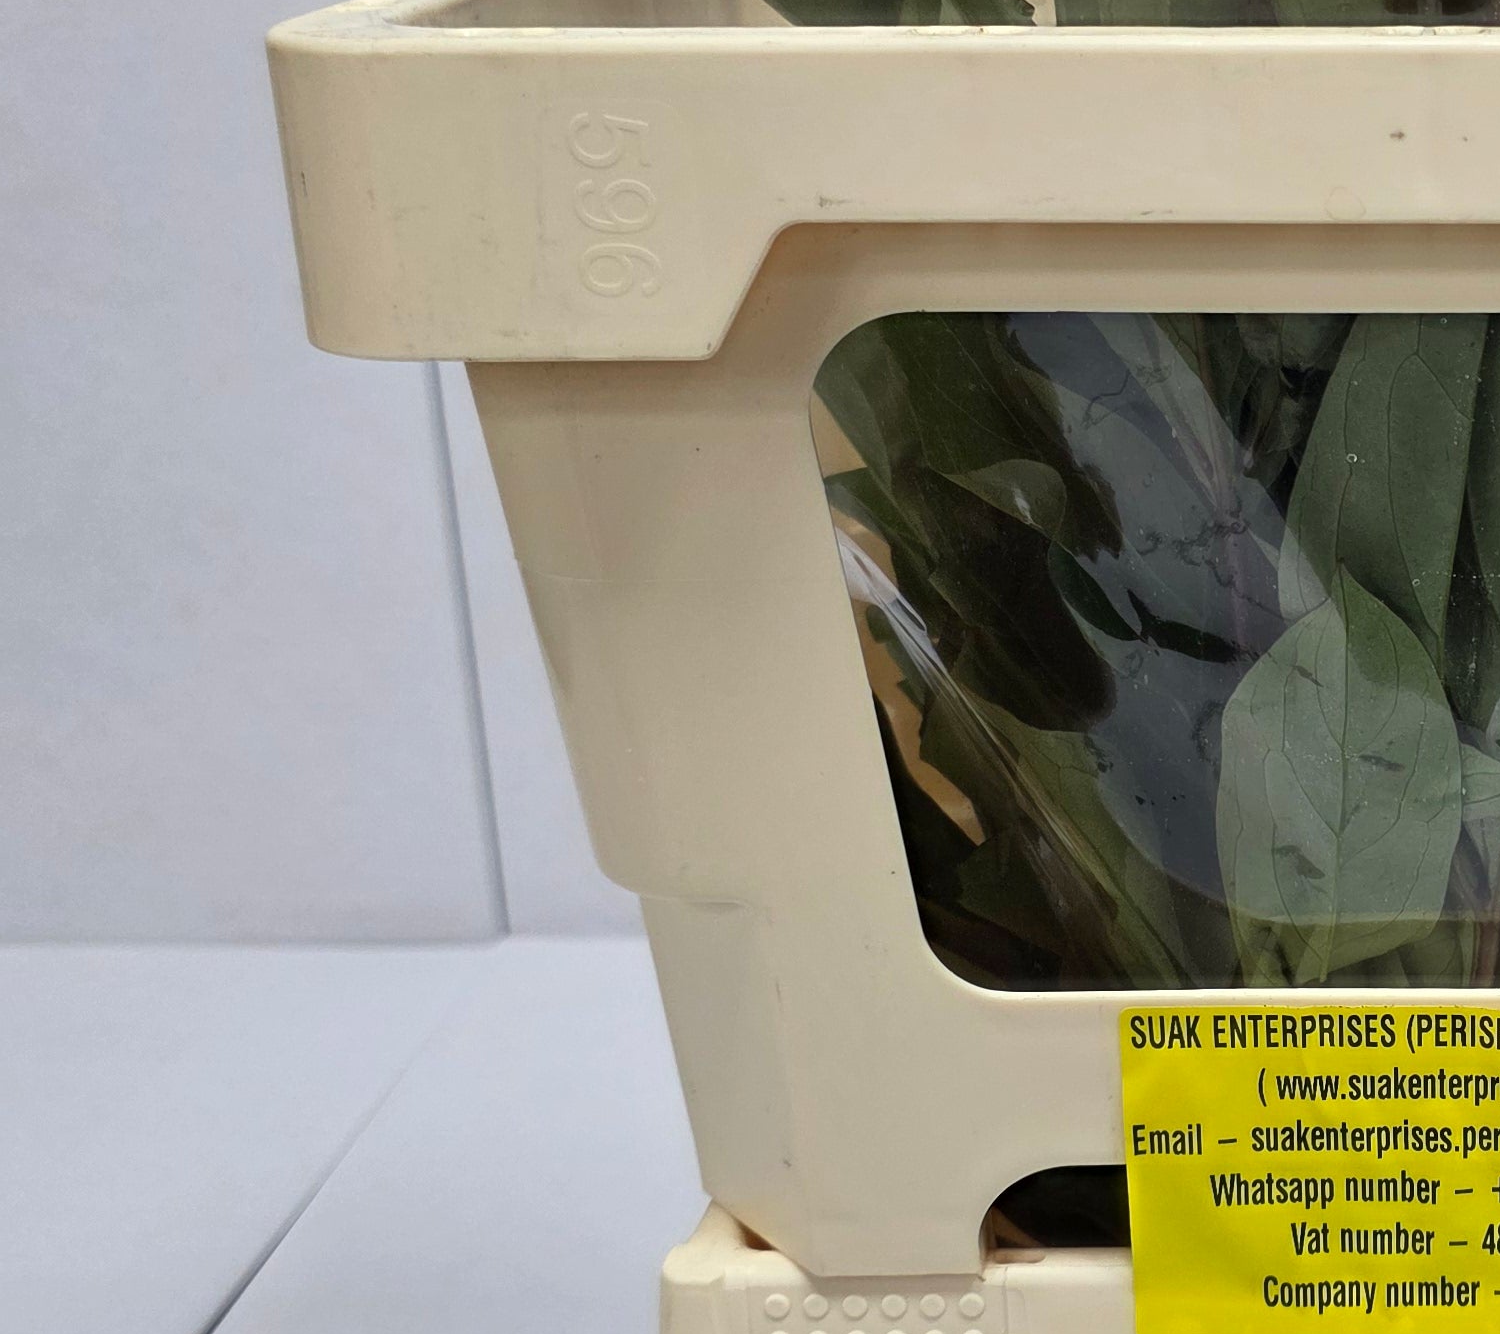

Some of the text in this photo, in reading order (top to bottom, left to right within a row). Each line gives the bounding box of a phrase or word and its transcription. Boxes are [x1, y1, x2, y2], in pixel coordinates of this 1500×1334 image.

[1130, 1015, 1202, 1050] SUAK
[1213, 1013, 1396, 1049] ENTERPRISES
[1132, 1123, 1203, 1156] Email
[1210, 1173, 1335, 1209] Whatsapp
[1345, 1170, 1441, 1205] number
[1291, 1222, 1330, 1256] Vat
[1340, 1222, 1435, 1255] number
[1263, 1274, 1376, 1315] Company
[1386, 1275, 1481, 1308] number
